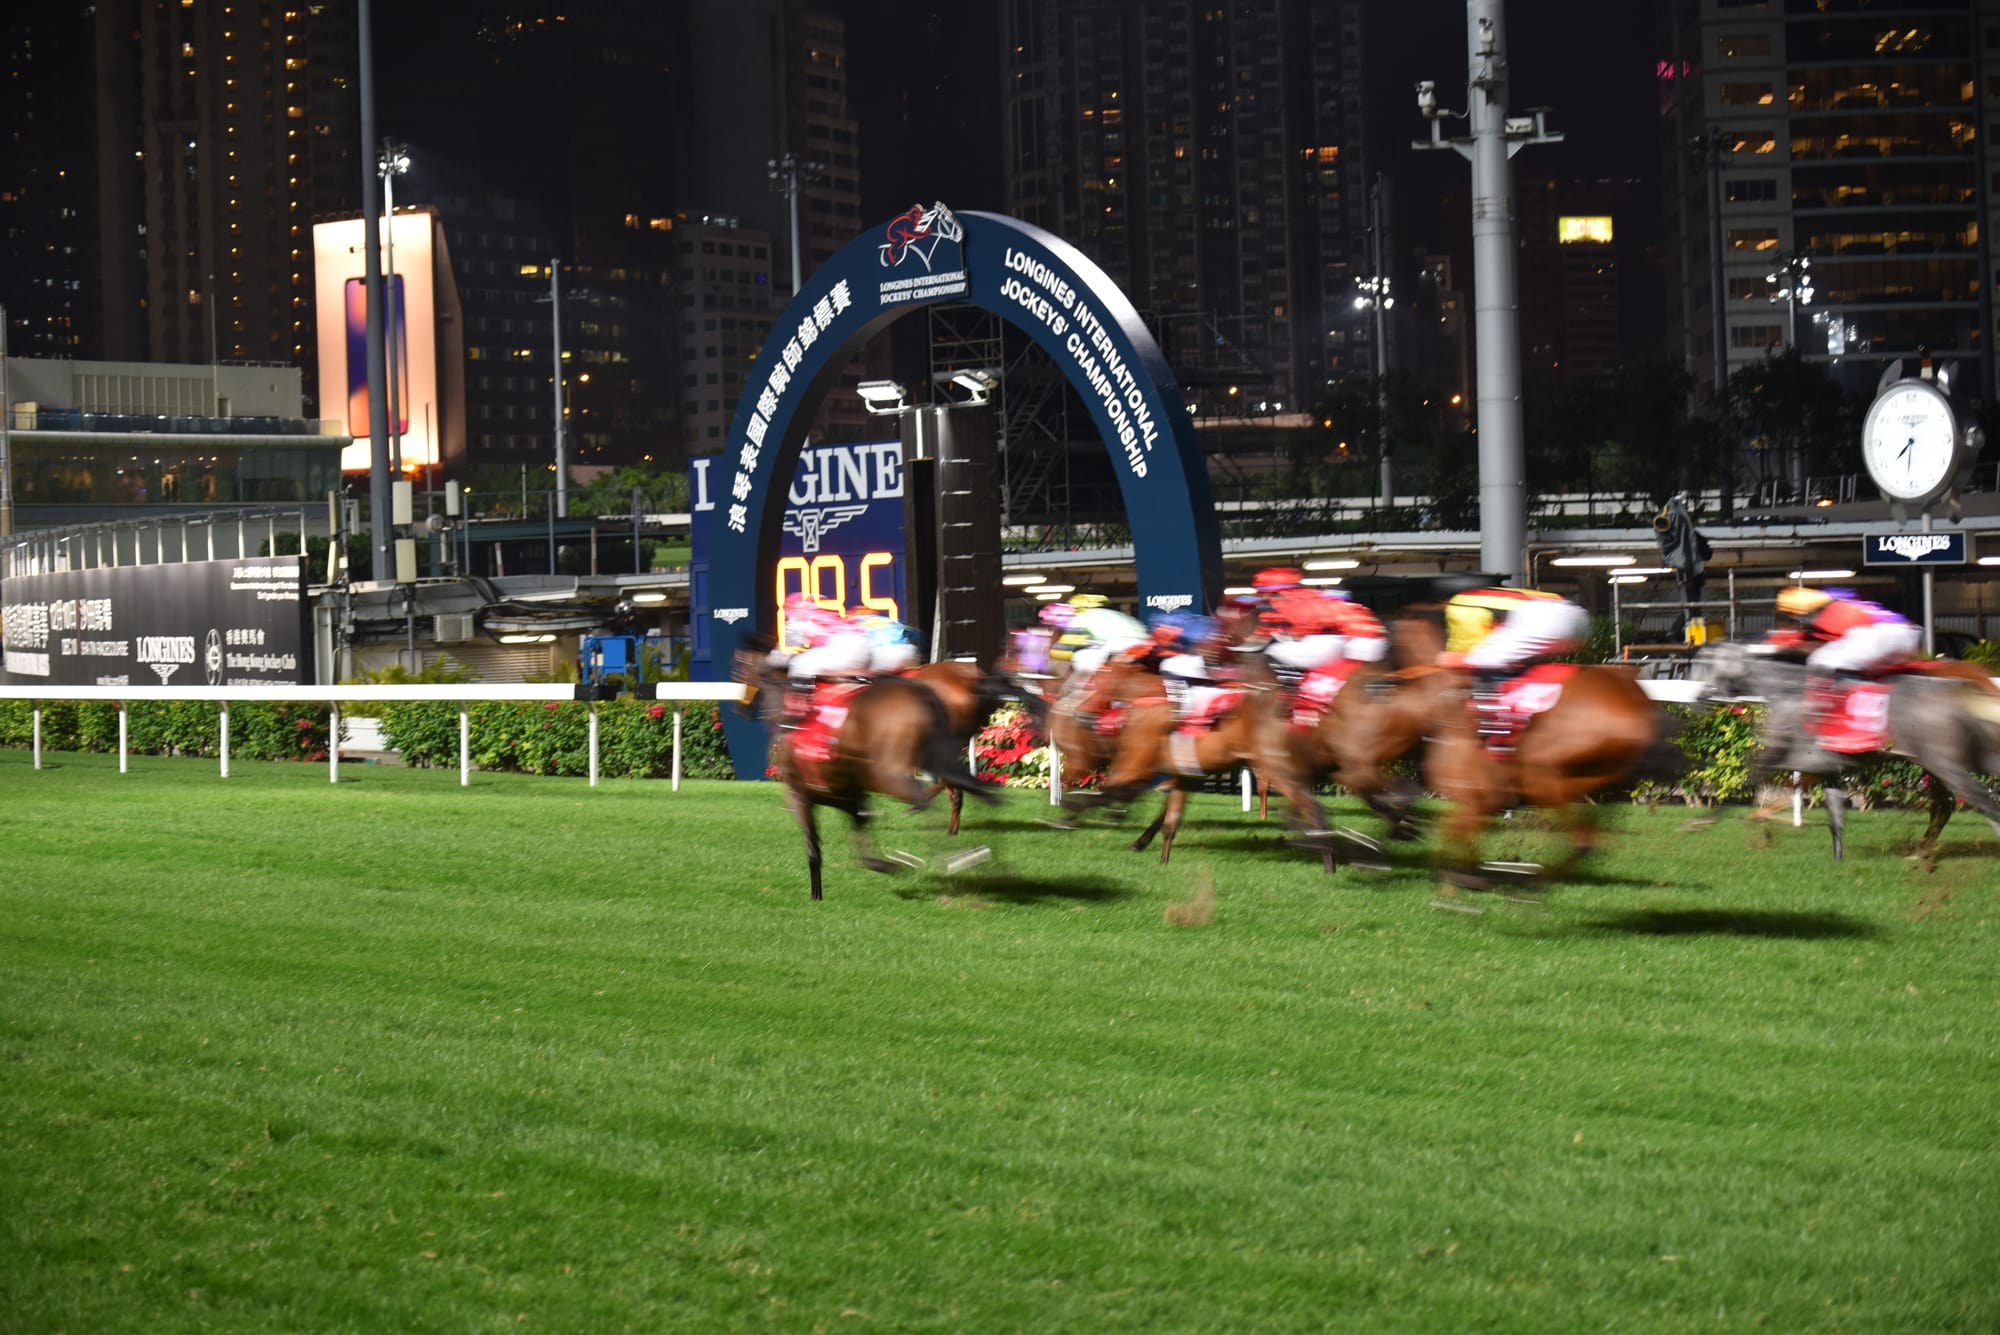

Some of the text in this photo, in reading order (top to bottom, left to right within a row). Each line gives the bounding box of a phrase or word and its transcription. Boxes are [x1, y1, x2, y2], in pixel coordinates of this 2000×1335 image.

[880, 279, 914, 291] LONGINES
[912, 282, 966, 299] CHAMPIONSHIP
[1004, 248, 1159, 451] LONGINES INTERNATIONAL
[1000, 277, 1148, 478] JOCKEYS' CHAMPIONSHIP
[1878, 535, 1951, 552] LONGINES
[1146, 595, 1193, 607] LONGINES
[136, 636, 195, 664] LONGINES
